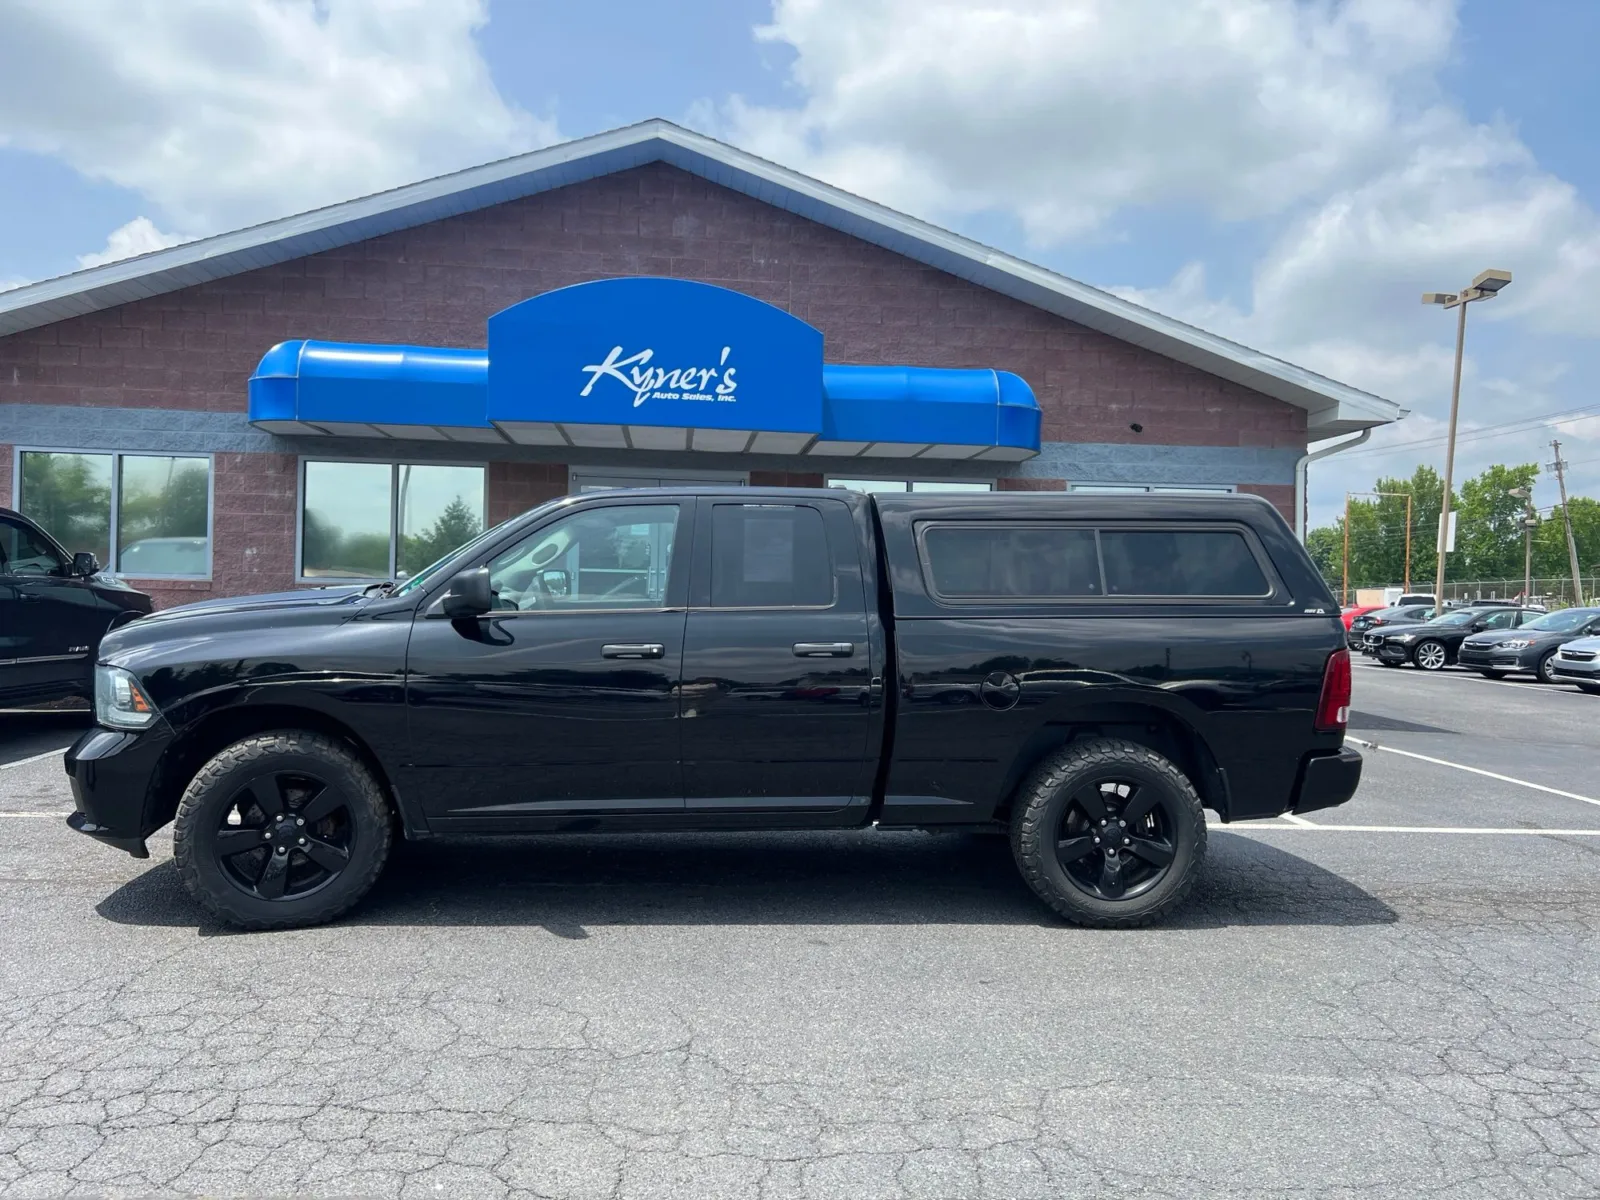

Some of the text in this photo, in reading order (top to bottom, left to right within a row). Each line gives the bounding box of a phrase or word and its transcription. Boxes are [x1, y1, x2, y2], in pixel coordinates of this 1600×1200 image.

[580, 345, 737, 408] Kyner's
[652, 391, 737, 402] Auto Sales, Inc.
